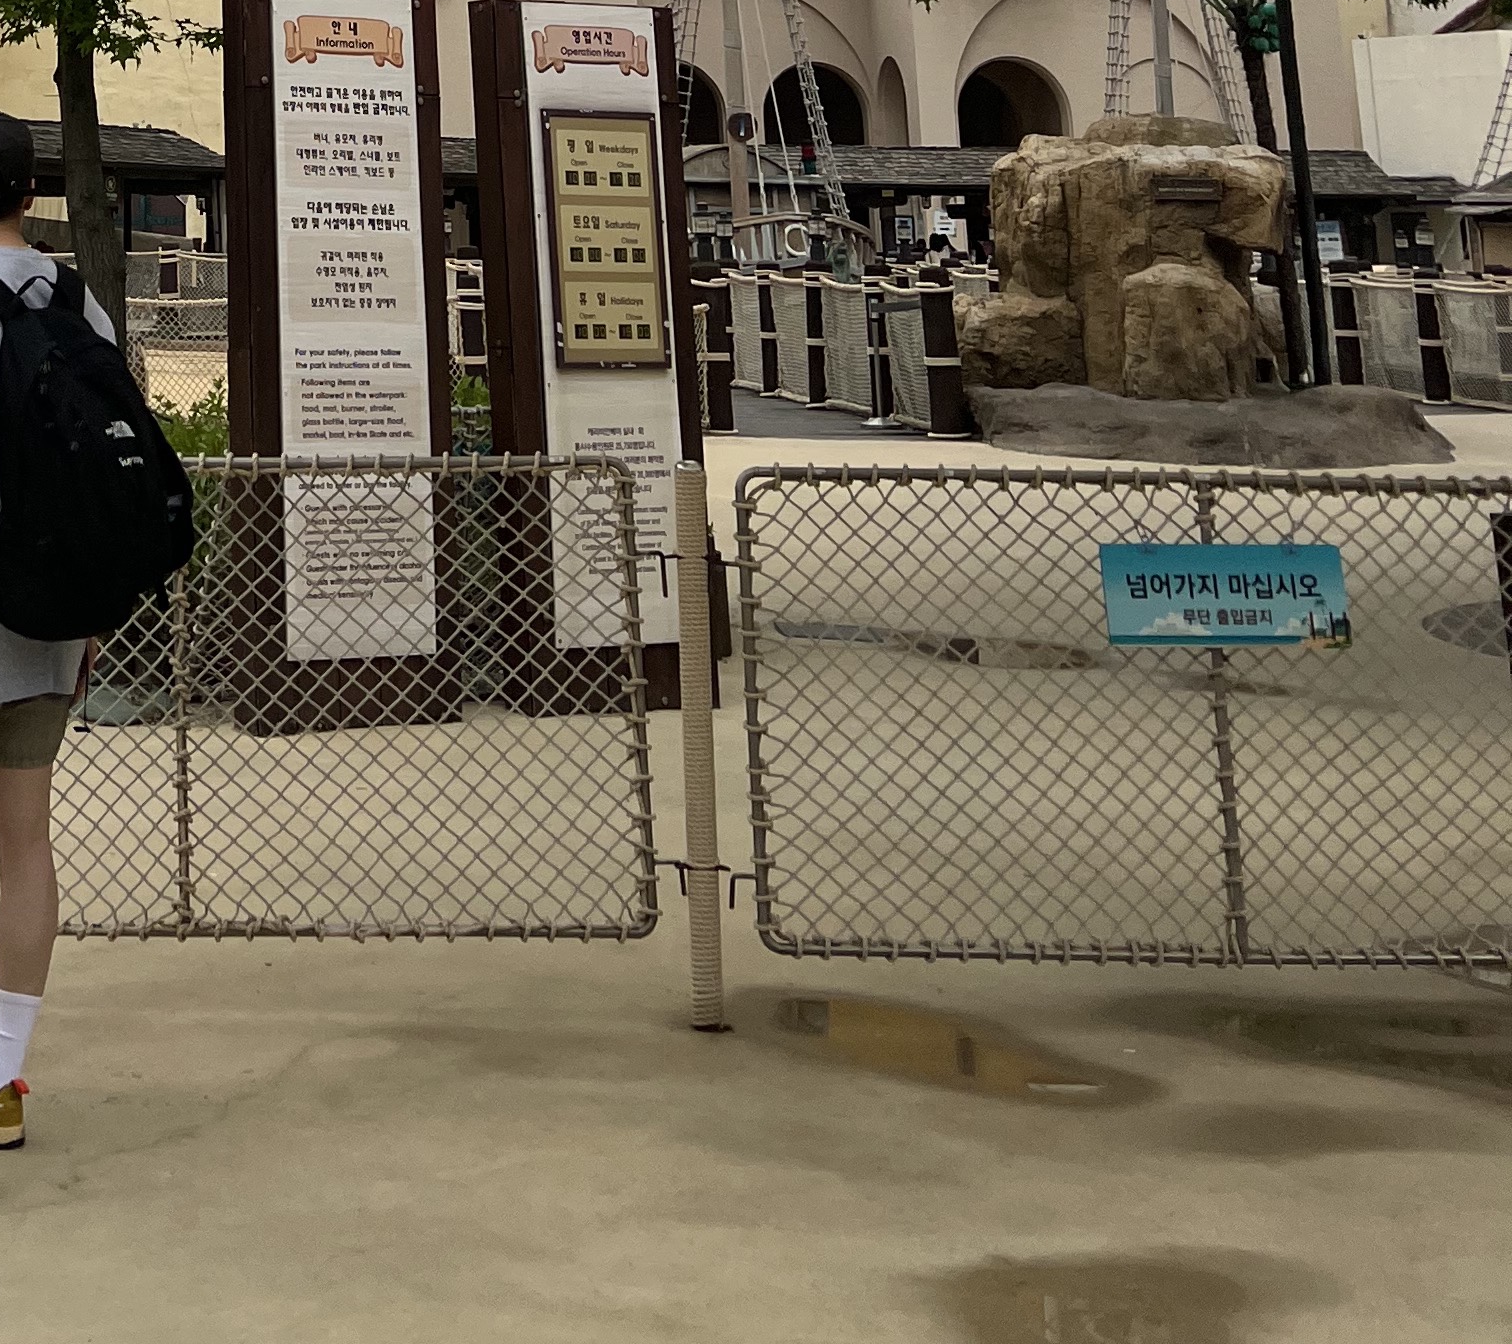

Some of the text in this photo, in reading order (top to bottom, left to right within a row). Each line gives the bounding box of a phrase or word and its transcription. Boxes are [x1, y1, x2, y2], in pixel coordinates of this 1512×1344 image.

[331, 20, 358, 36] 안 내
[315, 36, 375, 50] Information
[571, 30, 613, 45] 영업시간
[560, 46, 626, 58] Operation Hours
[290, 85, 322, 98] 안전하고
[352, 102, 369, 115] 반입
[598, 143, 639, 156] Weekdays
[307, 201, 395, 216] 다음에 해당되는 손님은
[291, 217, 308, 230] 입장
[573, 215, 641, 231] 토요일 Saturday
[610, 296, 644, 306] Holidays
[294, 347, 307, 356] For
[309, 349, 325, 357] your
[354, 348, 378, 358] please
[309, 362, 327, 371] park
[301, 378, 336, 387] Following
[1126, 573, 1322, 600] 넘어가지 마십시오
[1183, 609, 1273, 625] 무단 출입금지
